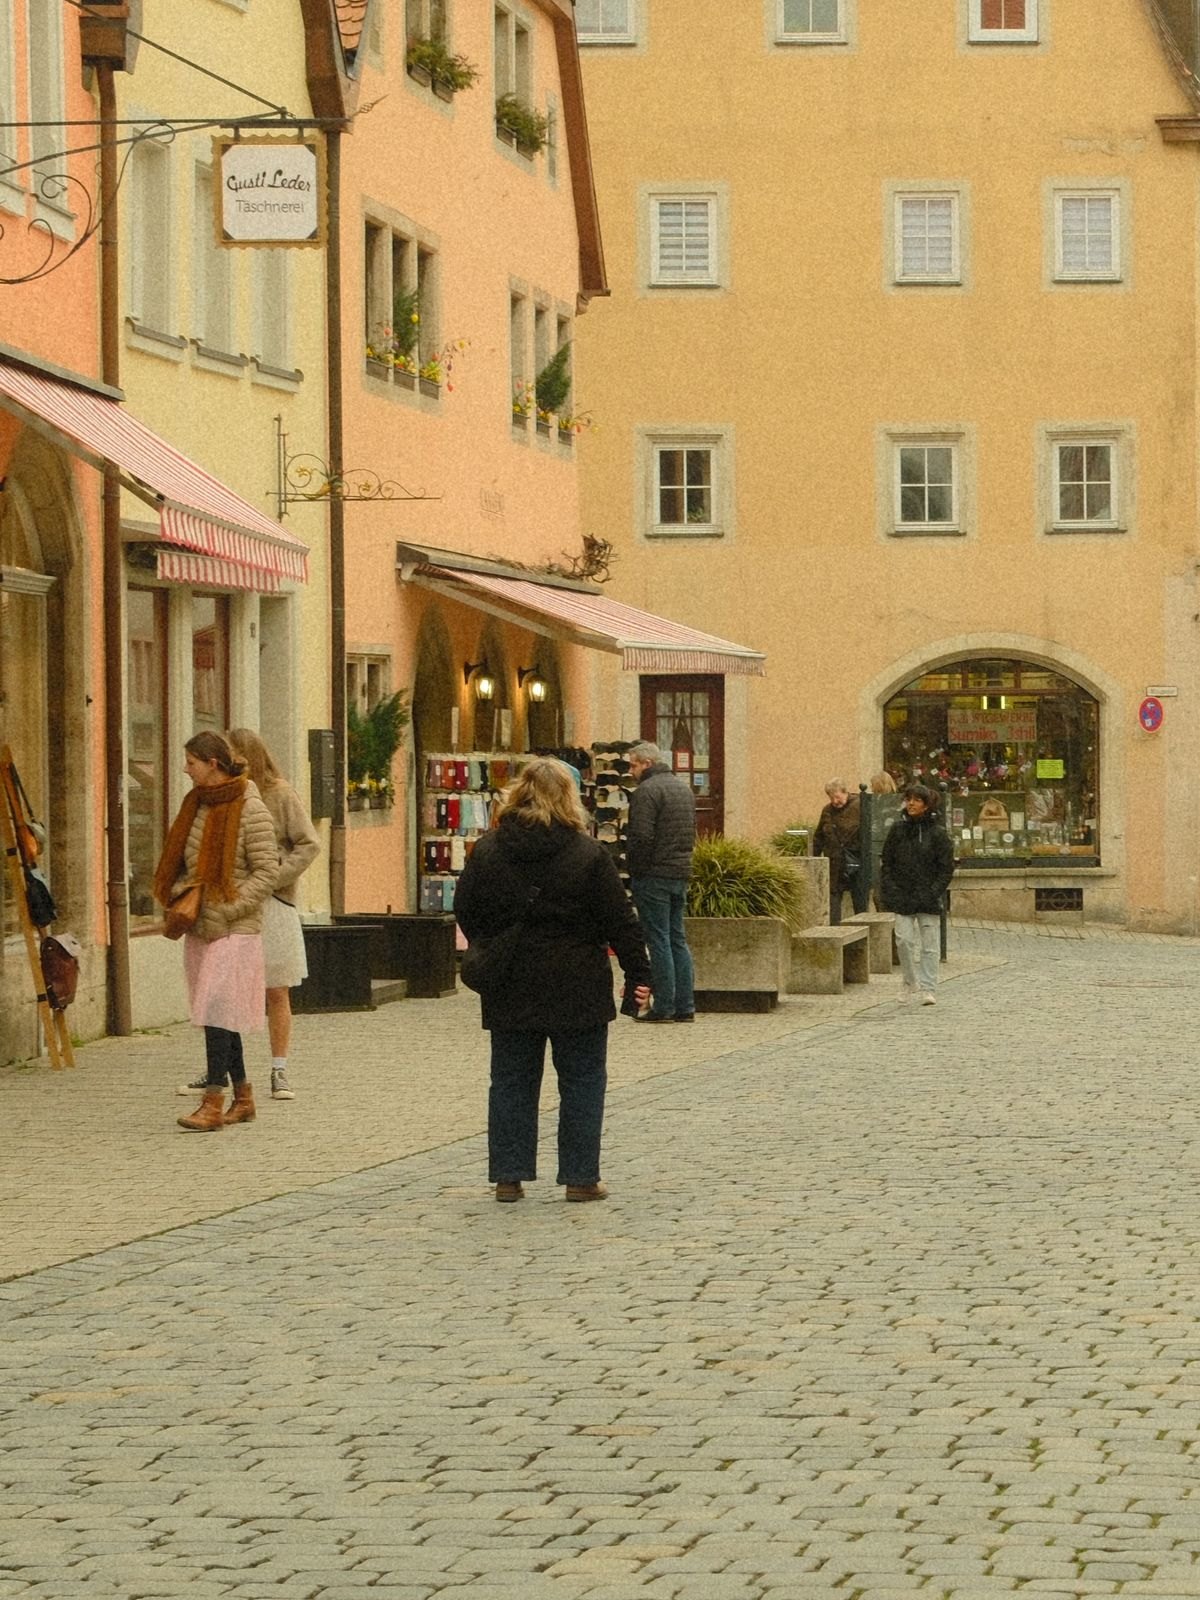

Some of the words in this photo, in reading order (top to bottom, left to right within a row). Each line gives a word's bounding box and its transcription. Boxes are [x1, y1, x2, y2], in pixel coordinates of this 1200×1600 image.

[226, 171, 266, 192] Gusti
[267, 169, 311, 192] Leder
[235, 199, 304, 213] Taschnerei
